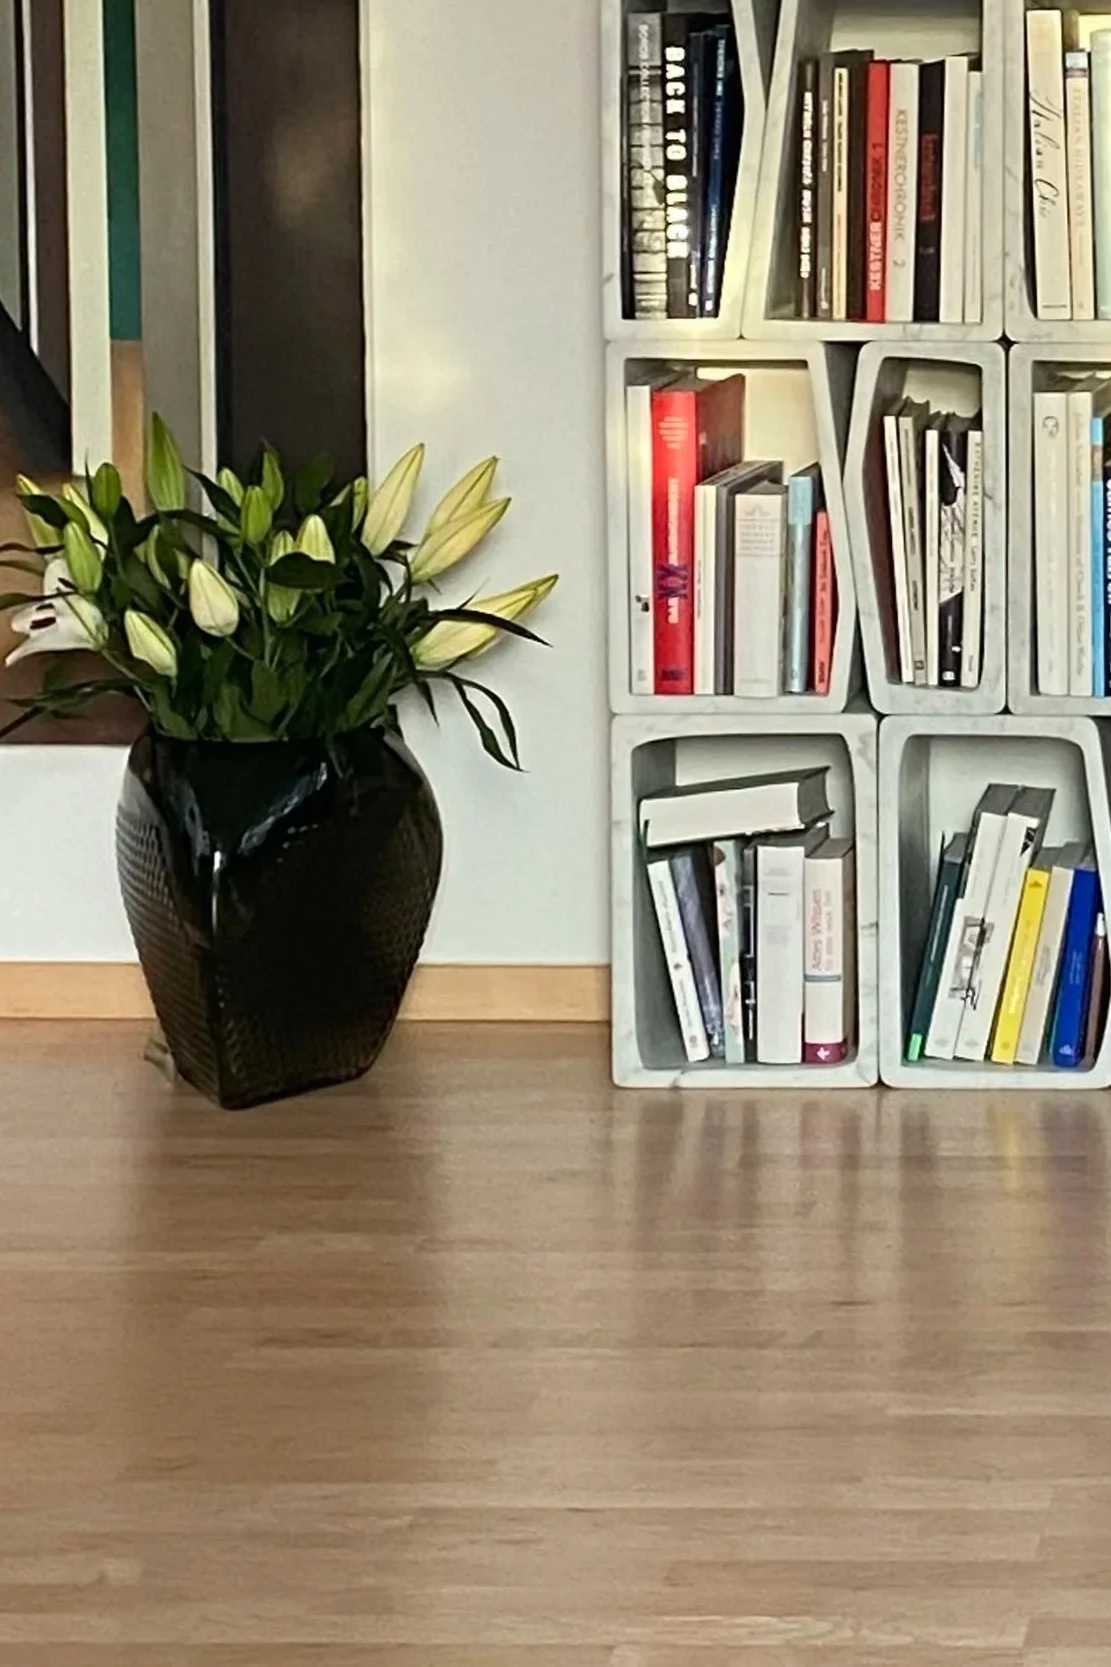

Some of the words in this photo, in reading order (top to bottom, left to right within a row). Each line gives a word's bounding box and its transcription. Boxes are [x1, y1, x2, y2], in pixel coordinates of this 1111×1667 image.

[664, 46, 686, 114] BACK
[664, 128, 687, 161] TO
[1029, 91, 1062, 169] Italian
[894, 108, 909, 240] KESTNERCHRONIK
[664, 173, 689, 259] BLACK
[971, 499, 981, 538] AVENUE
